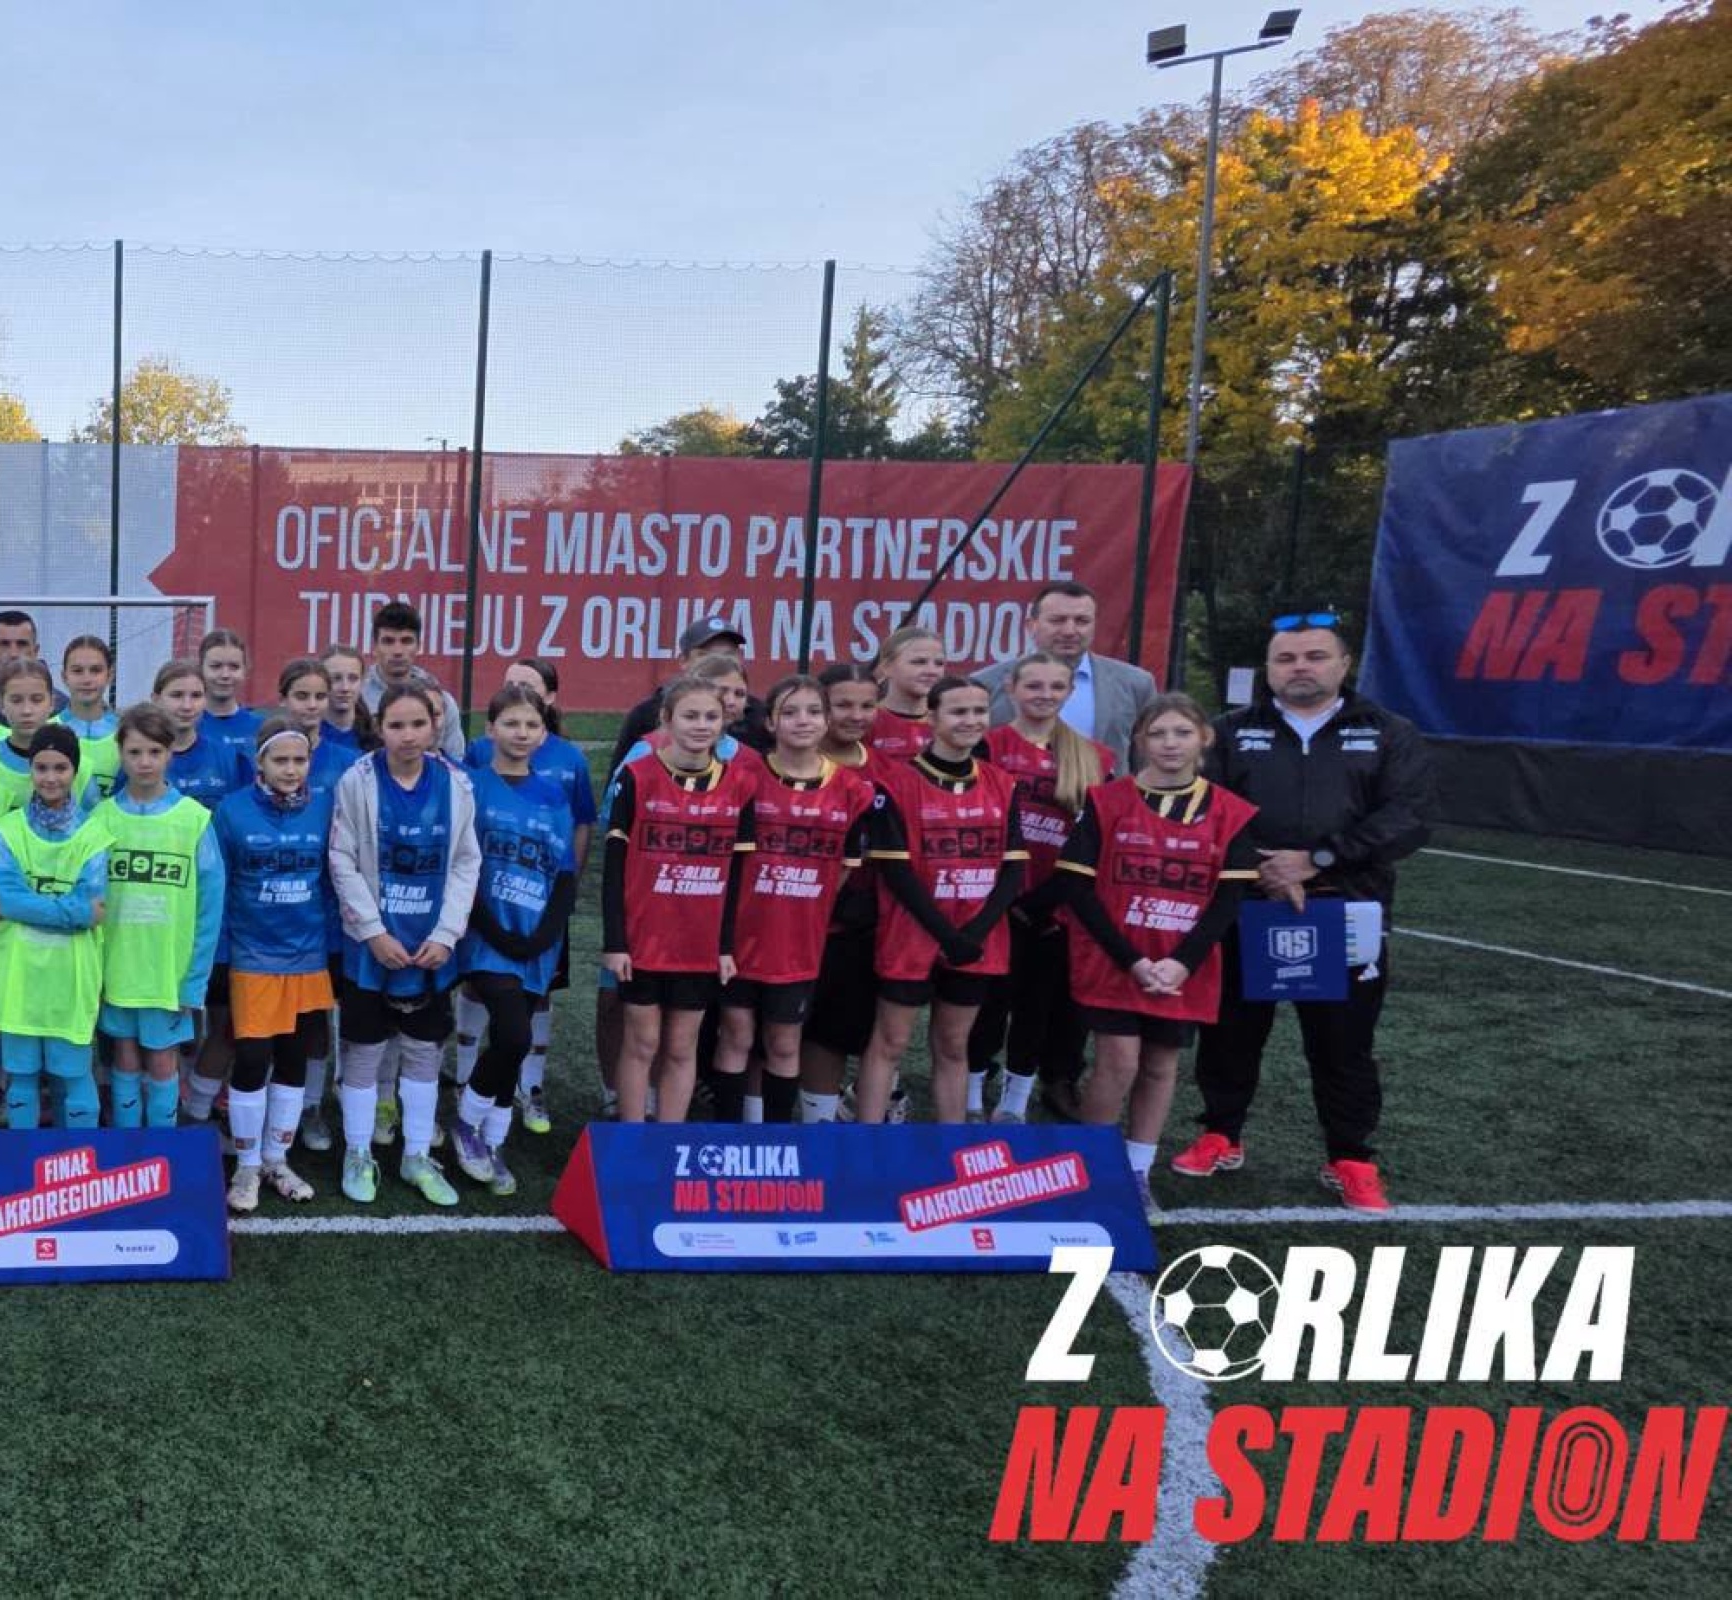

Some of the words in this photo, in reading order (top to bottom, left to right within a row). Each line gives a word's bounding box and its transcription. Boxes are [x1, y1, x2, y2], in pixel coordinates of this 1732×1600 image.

[275, 505, 531, 574] OFICJALNE
[543, 511, 732, 578] MIASTO
[745, 514, 1077, 582] PARTNERSKIE
[1495, 479, 1577, 577] Z
[536, 596, 569, 658] Z
[770, 599, 837, 663] NA
[1455, 588, 1602, 682] NA
[44, 1151, 91, 1185] FINAŁ
[674, 1145, 691, 1176] Z
[905, 1159, 1080, 1227] MAKROREGIONALNY
[961, 1145, 1008, 1177] FINAŁ
[673, 1180, 711, 1212] NA
[716, 1179, 825, 1212] STADION
